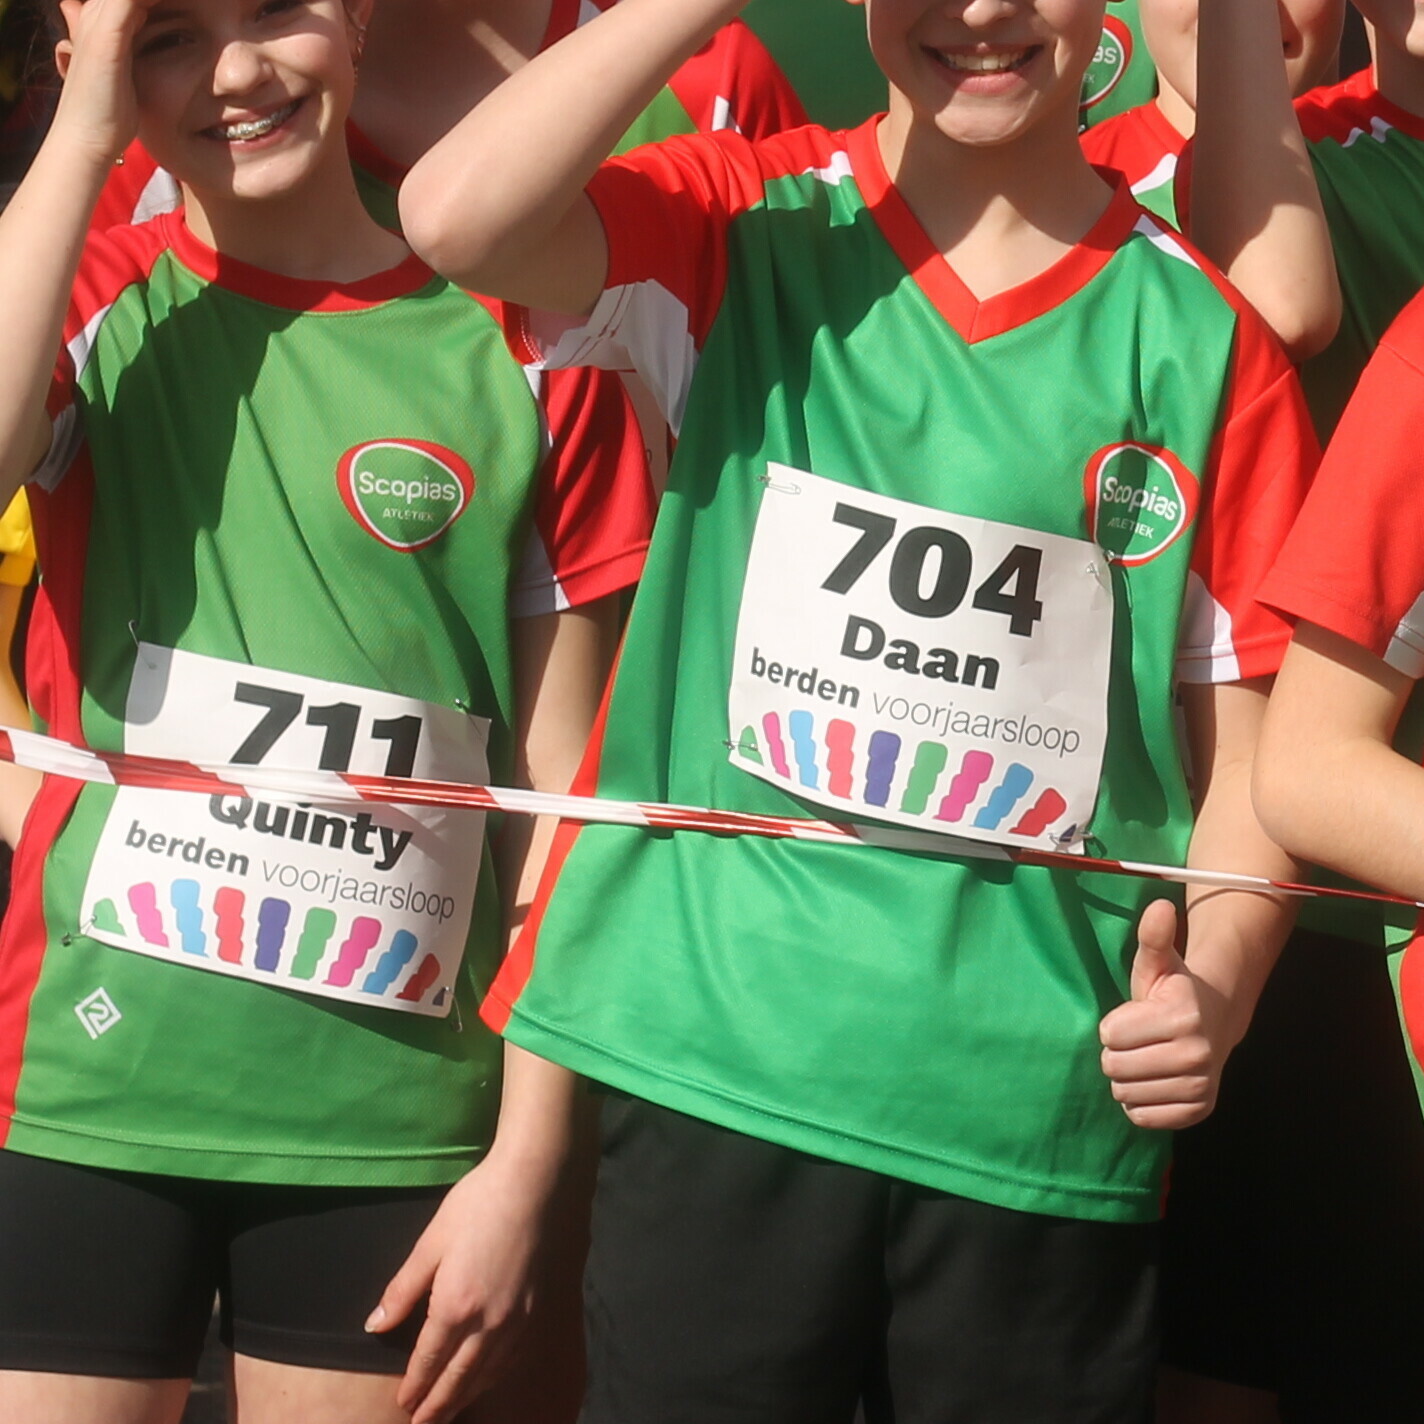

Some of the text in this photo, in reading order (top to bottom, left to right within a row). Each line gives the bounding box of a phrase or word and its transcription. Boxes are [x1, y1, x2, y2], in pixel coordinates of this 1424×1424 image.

[358, 471, 457, 504] Scopias
[382, 507, 435, 521] ATLETIEK
[1102, 476, 1178, 521] Scopias
[820, 502, 1043, 638] 704
[840, 614, 1000, 690] Daan
[229, 681, 423, 778] 711
[751, 647, 1081, 760] berden voorjaarsloop
[208, 794, 414, 871] Quinty
[125, 819, 455, 924] berden voorjaarsloop
